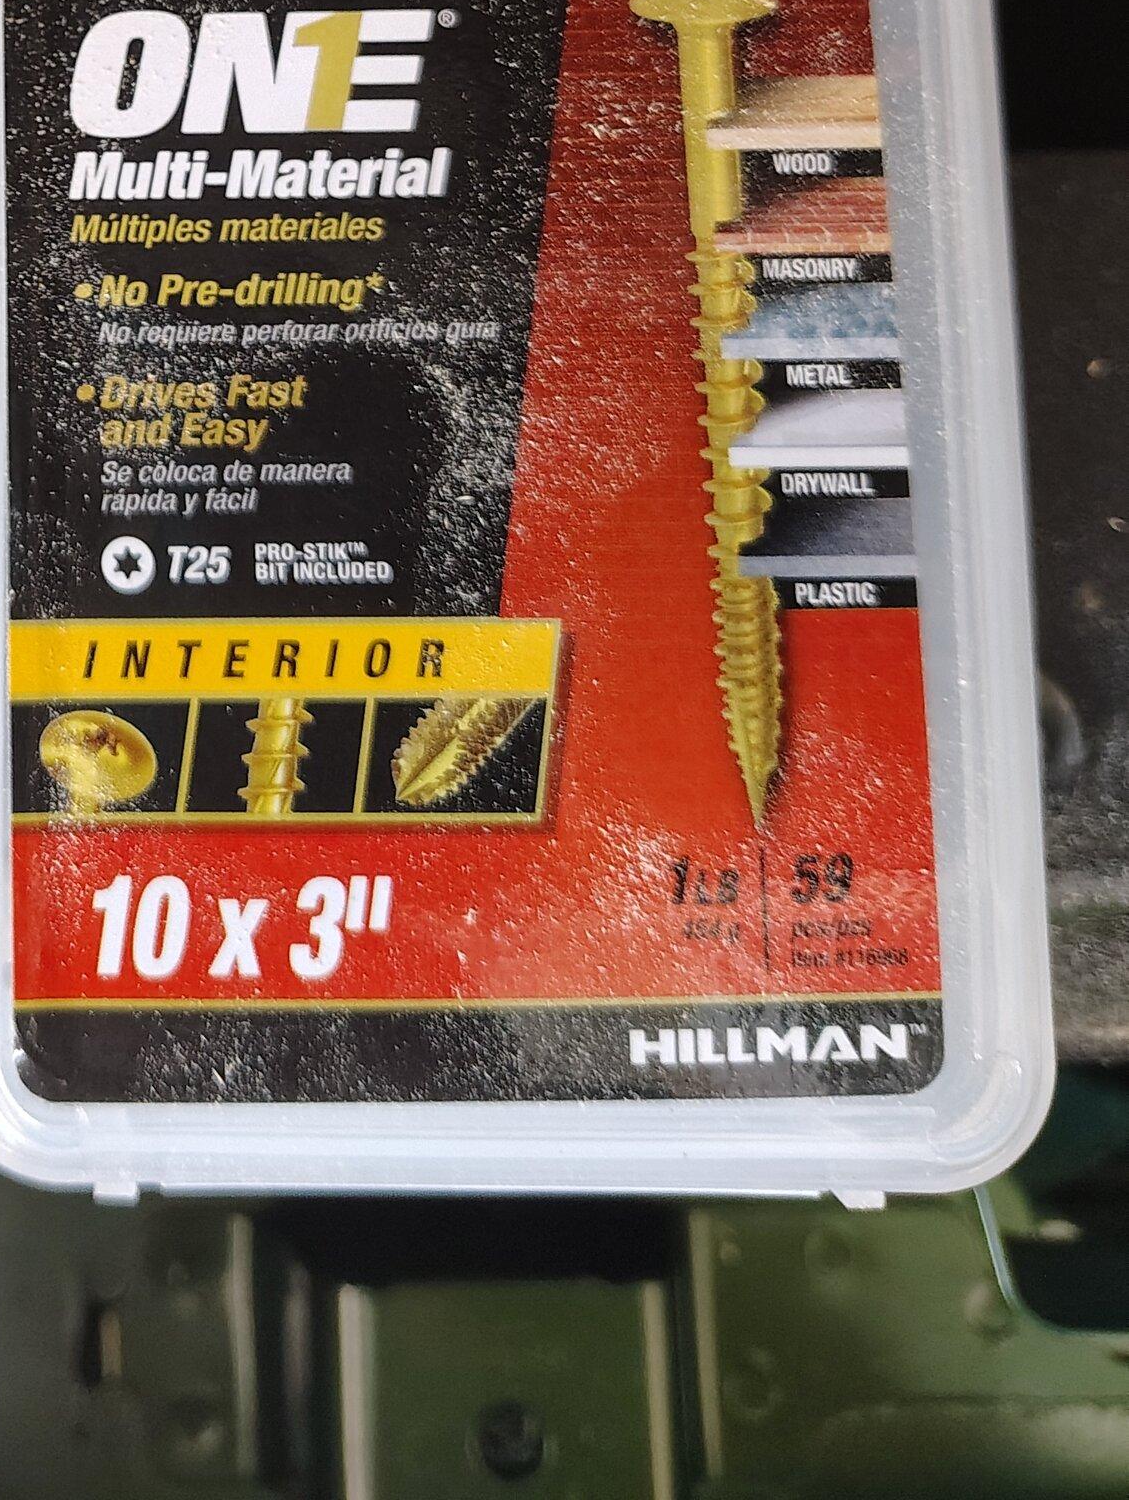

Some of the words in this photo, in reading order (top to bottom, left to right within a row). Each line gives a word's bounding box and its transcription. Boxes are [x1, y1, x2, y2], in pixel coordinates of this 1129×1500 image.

[71, 147, 452, 200] Multi-Material
[772, 151, 832, 176] WOOD
[71, 213, 212, 248] Múltiples
[219, 212, 385, 243] materiales
[762, 255, 858, 283] MASONRY
[98, 274, 148, 309] No
[98, 322, 132, 346] No
[133, 322, 236, 350] requiere
[241, 320, 338, 348] perforar
[344, 318, 440, 344] orificios
[99, 374, 223, 411] Drives
[226, 373, 308, 410] Fast
[786, 362, 853, 389] METAL
[100, 413, 172, 448] and
[179, 412, 270, 454] Easy
[99, 460, 134, 485] Se
[138, 459, 217, 485] coloca
[222, 458, 253, 484] de
[258, 462, 353, 486] manera
[780, 470, 875, 498] DRYWALL
[100, 485, 178, 517] rápida
[181, 491, 198, 517] y
[204, 485, 258, 513] fácil
[167, 545, 234, 583] T25
[254, 561, 290, 583] BIT
[292, 561, 395, 584] INCLUDED
[795, 580, 879, 608] PLASTIC
[83, 638, 447, 679] INTERIOR
[790, 852, 855, 905] 59
[92, 873, 192, 982] 10
[209, 898, 270, 980] x
[288, 873, 394, 982] 3"
